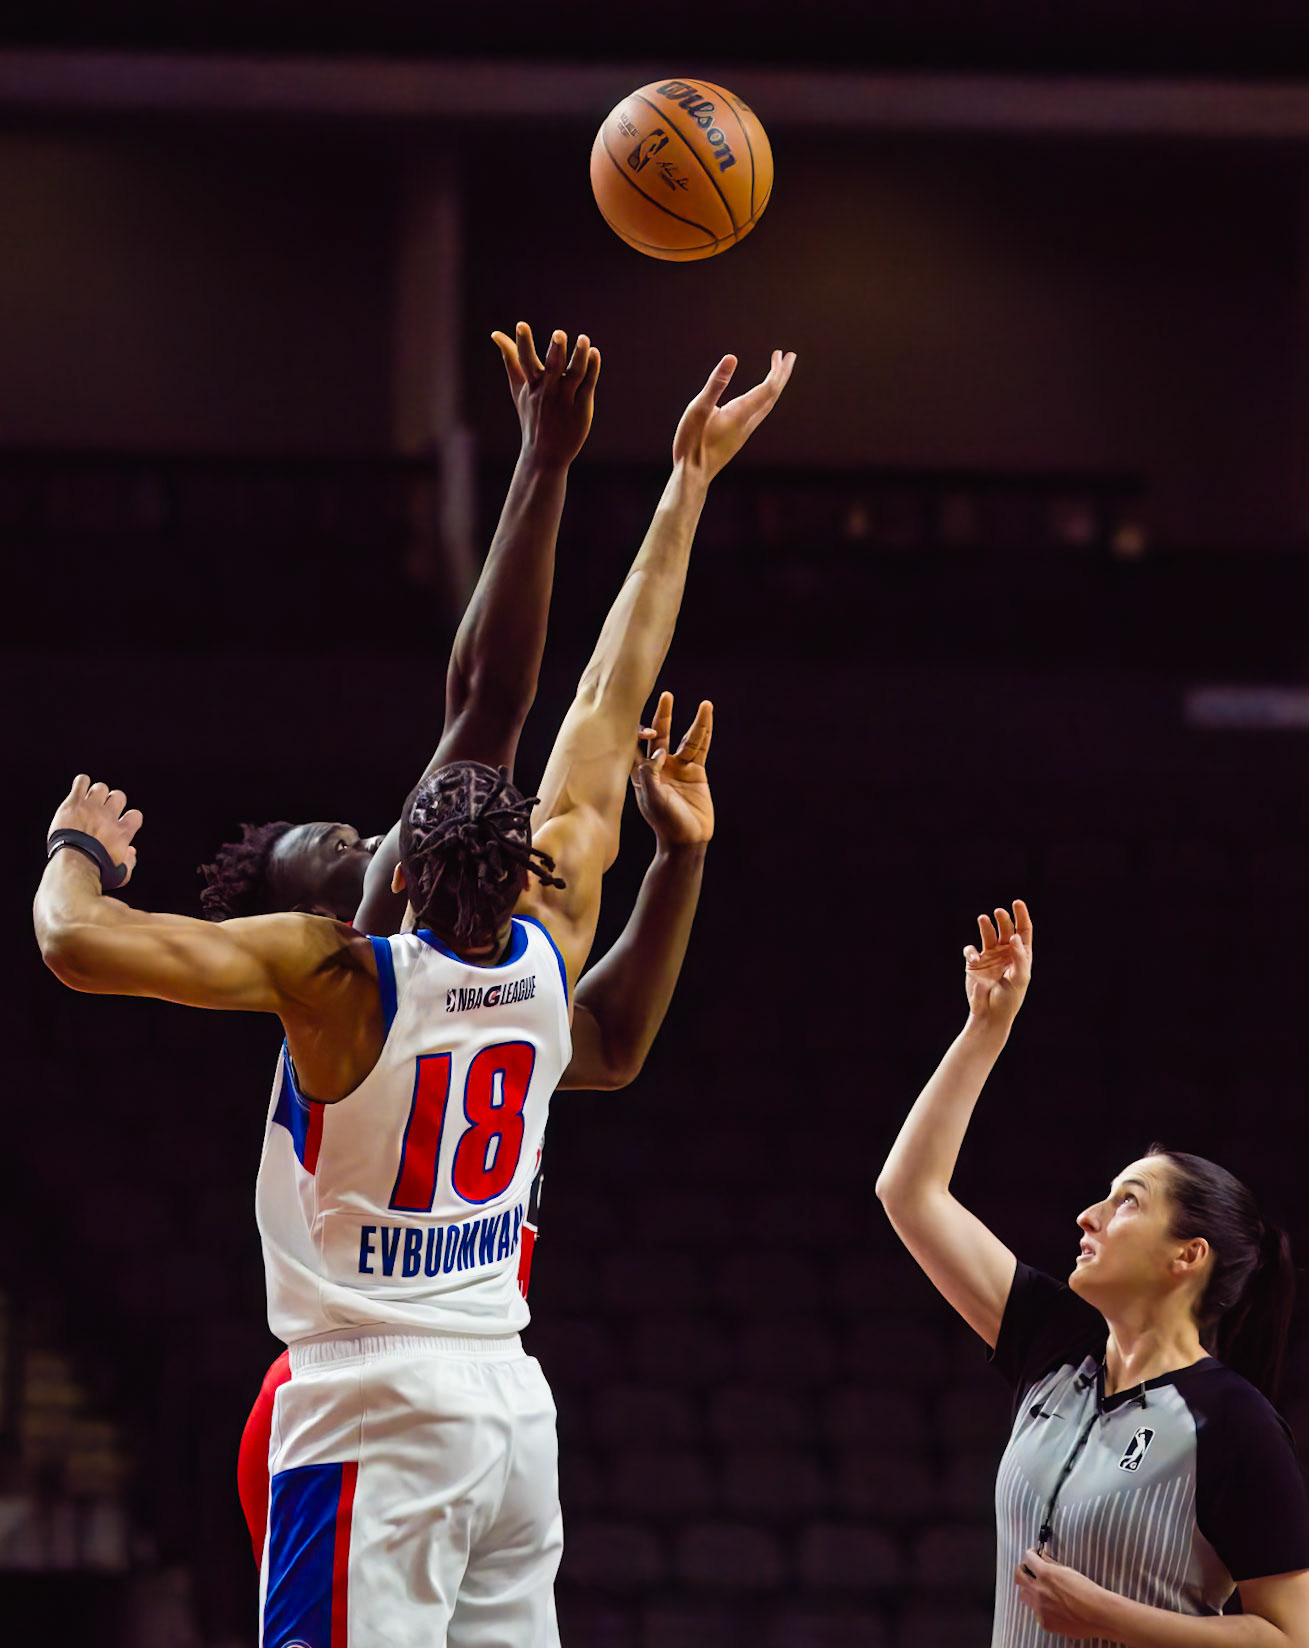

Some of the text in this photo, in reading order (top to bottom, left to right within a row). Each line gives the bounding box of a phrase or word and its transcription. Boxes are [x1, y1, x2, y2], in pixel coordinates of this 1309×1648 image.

[656, 81, 737, 173] Wilson
[457, 975, 536, 1012] NBA G LEAGUE
[388, 1040, 536, 1213] 18
